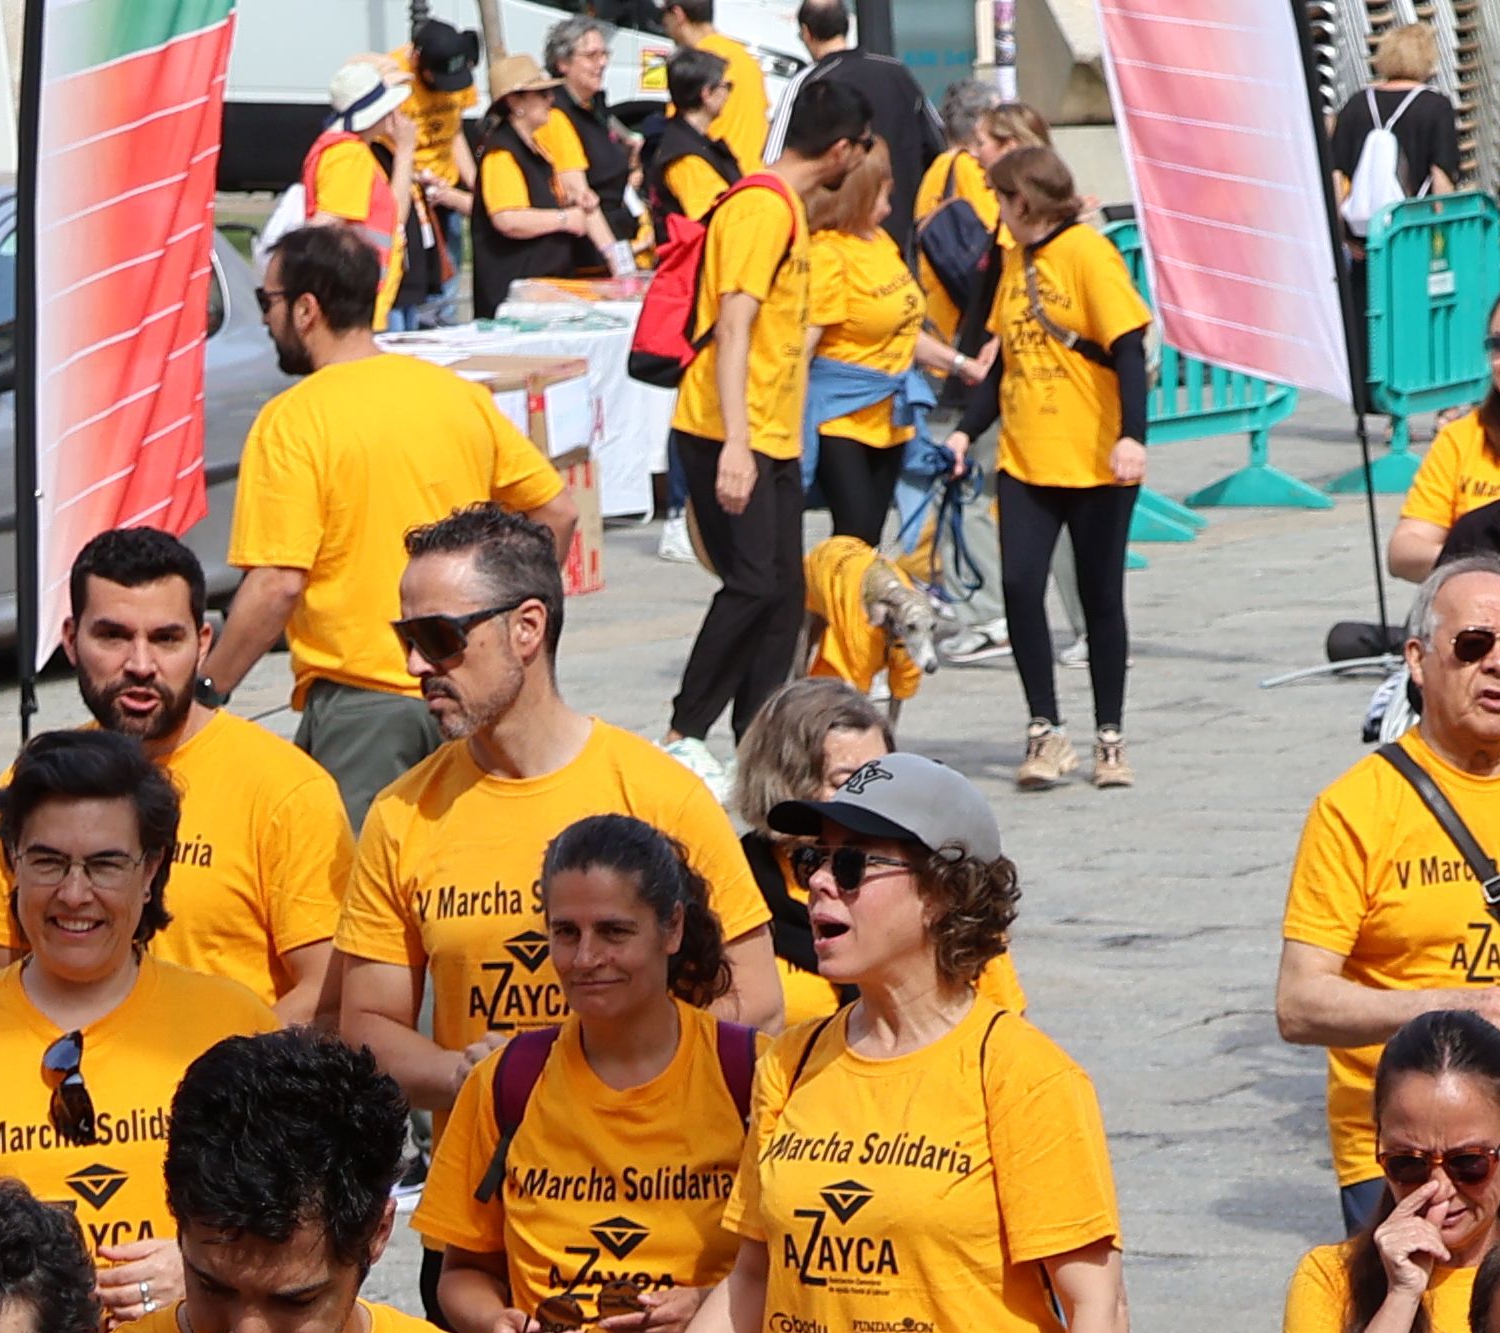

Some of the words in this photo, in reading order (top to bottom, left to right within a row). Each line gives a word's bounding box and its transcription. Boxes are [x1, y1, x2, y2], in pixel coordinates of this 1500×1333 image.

[440, 887, 522, 918] Marcha
[774, 1132, 852, 1163] Marcha
[858, 1133, 973, 1176] Solidaria
[524, 1165, 615, 1202] Marcha
[623, 1163, 733, 1201] Solidaria
[783, 1208, 899, 1288] AZAYCA
